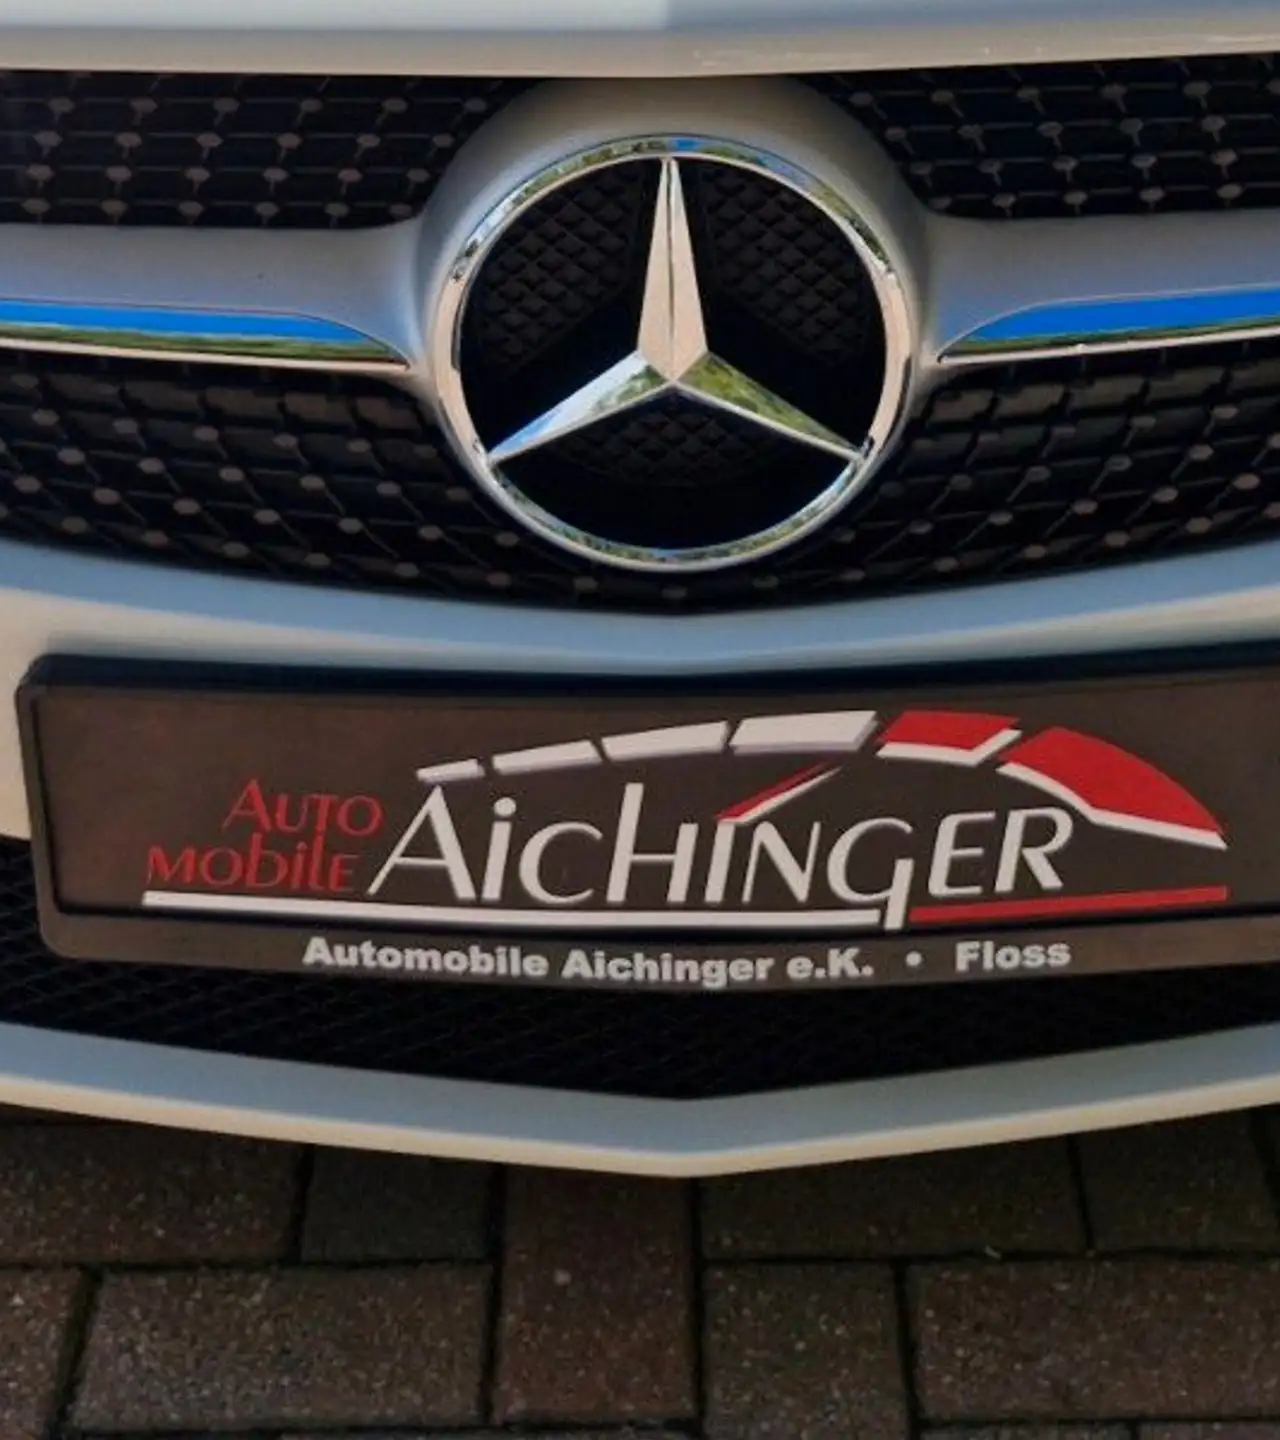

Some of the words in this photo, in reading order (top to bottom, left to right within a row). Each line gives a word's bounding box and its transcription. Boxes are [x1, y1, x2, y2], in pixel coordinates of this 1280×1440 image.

[302, 935, 550, 977] Automobile
[560, 948, 775, 989] Aichinger
[785, 945, 876, 980] e.K.
[954, 939, 1072, 973] Floss
